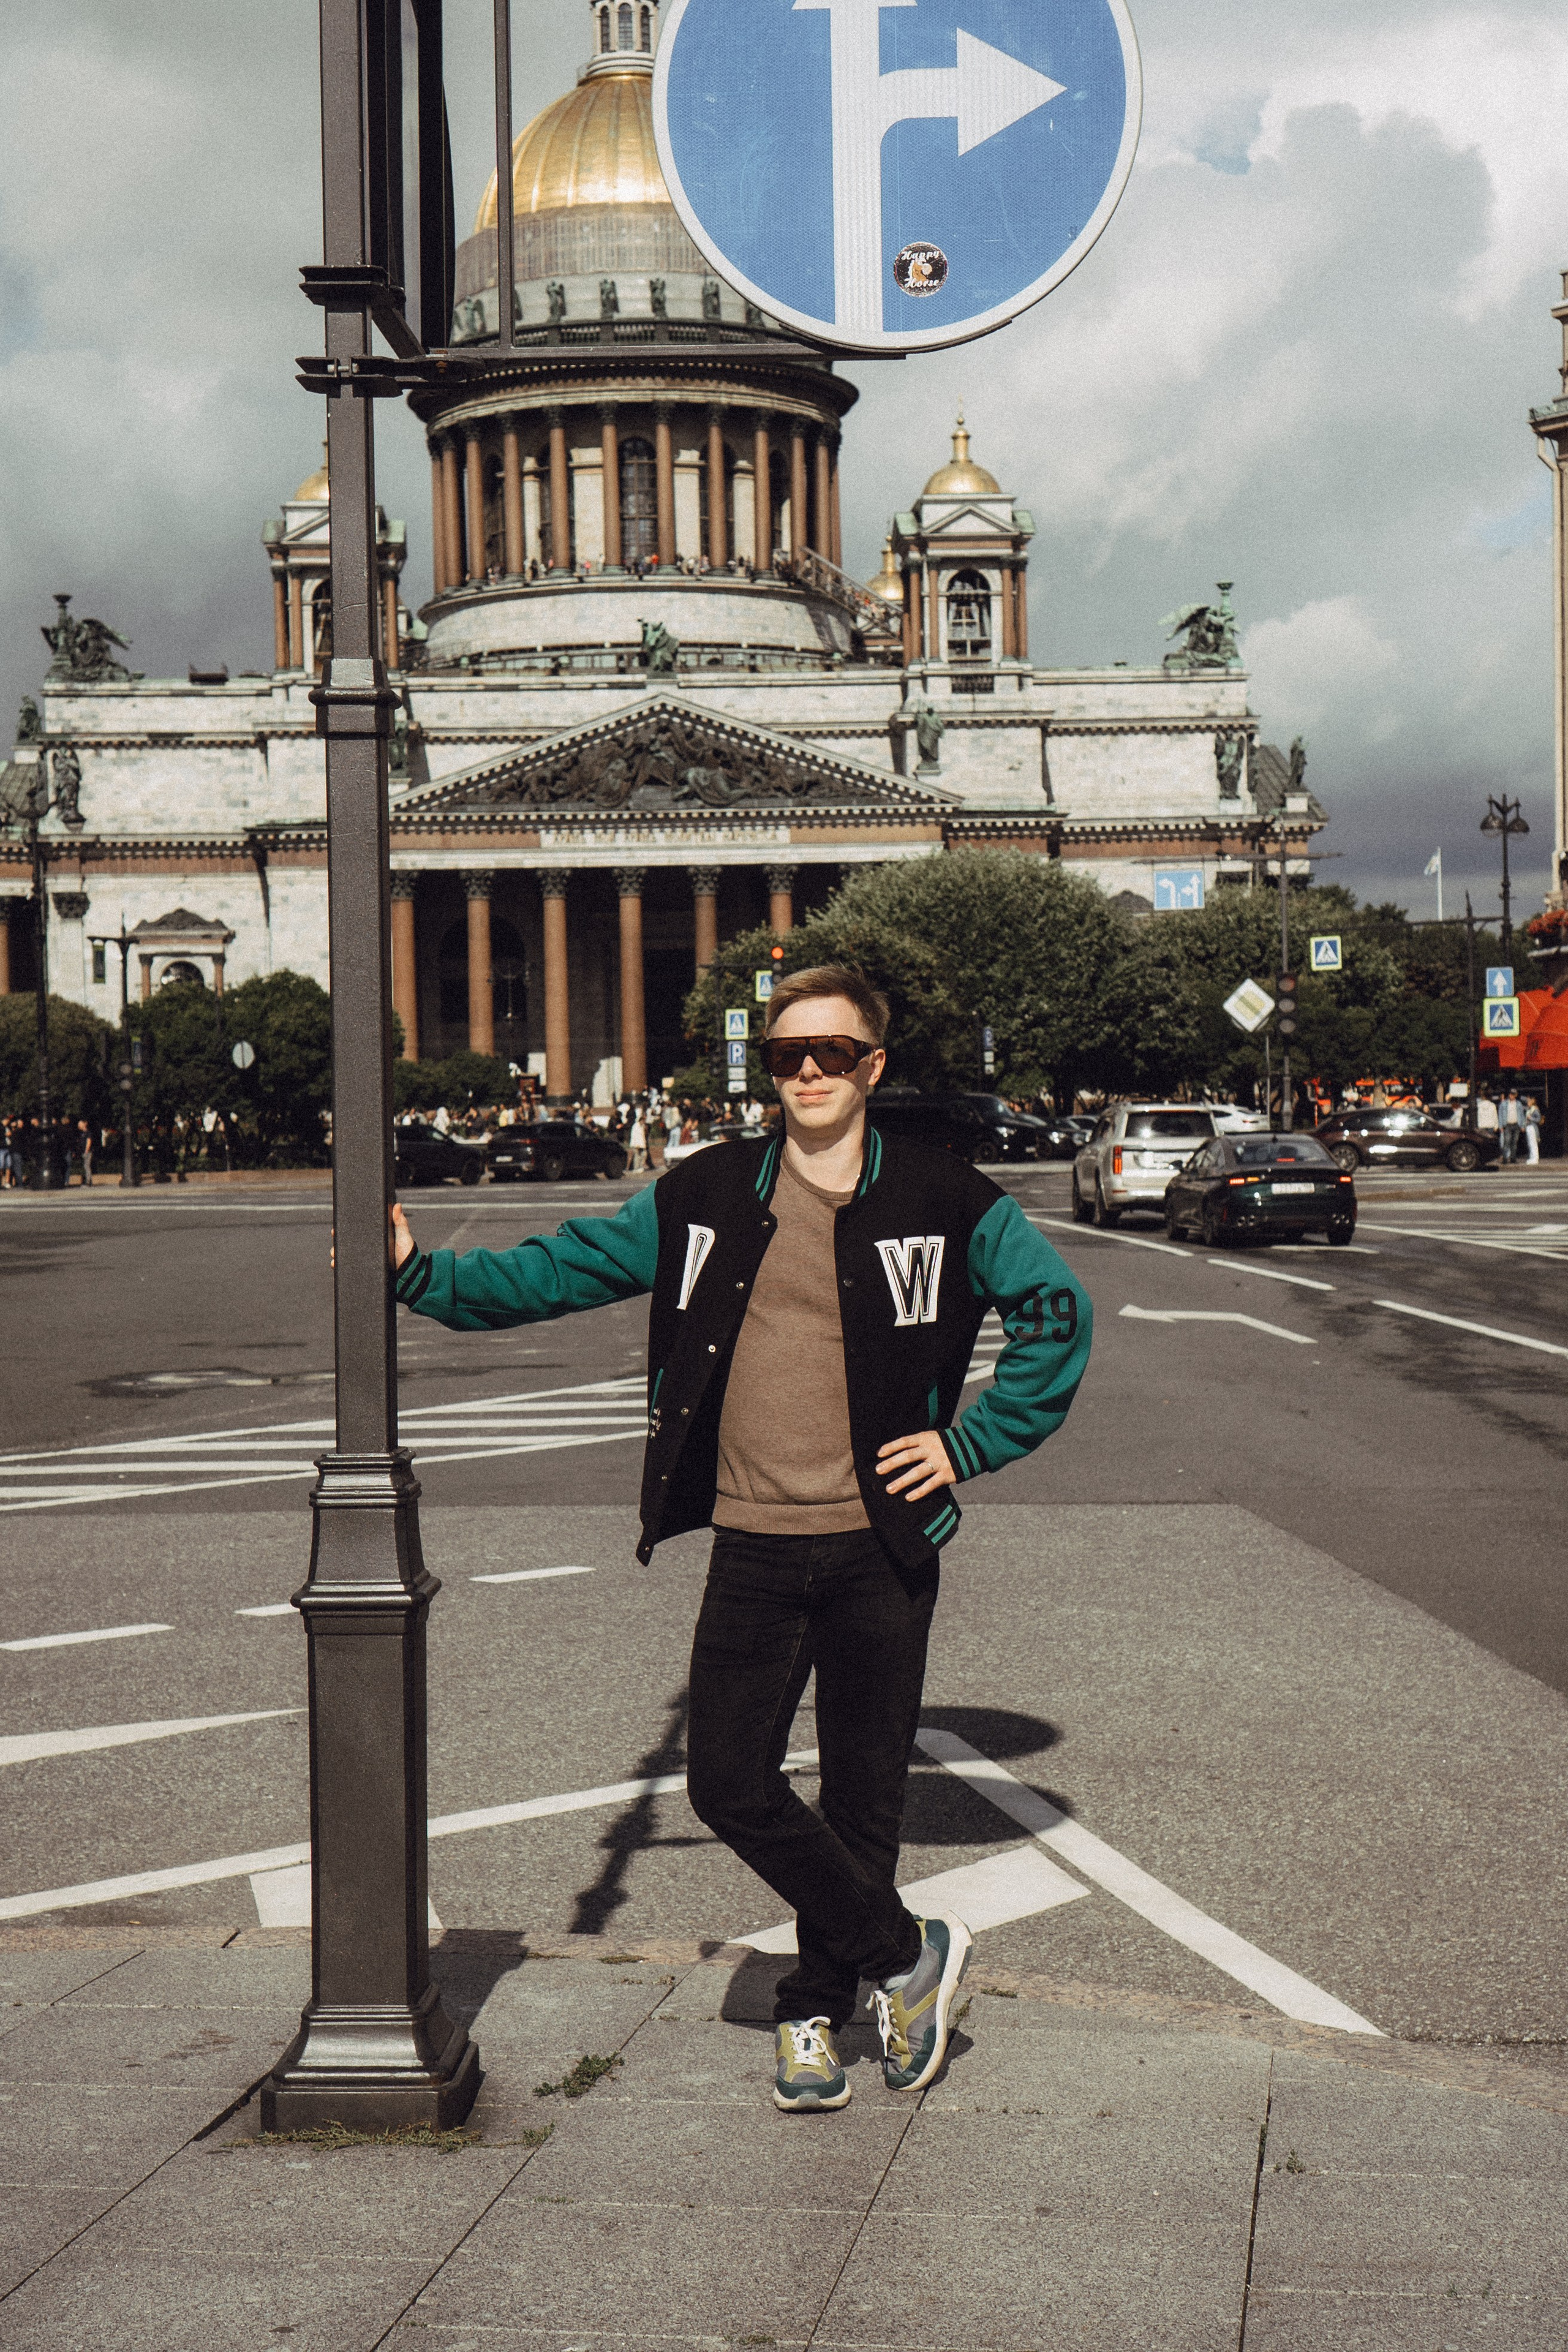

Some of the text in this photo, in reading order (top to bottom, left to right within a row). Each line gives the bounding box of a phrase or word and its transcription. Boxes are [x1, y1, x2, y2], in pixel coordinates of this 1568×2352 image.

[901, 251, 940, 260] Happy
[732, 1044, 743, 1062] P
[873, 1235, 945, 1327] W
[1014, 1287, 1077, 1343] 99
